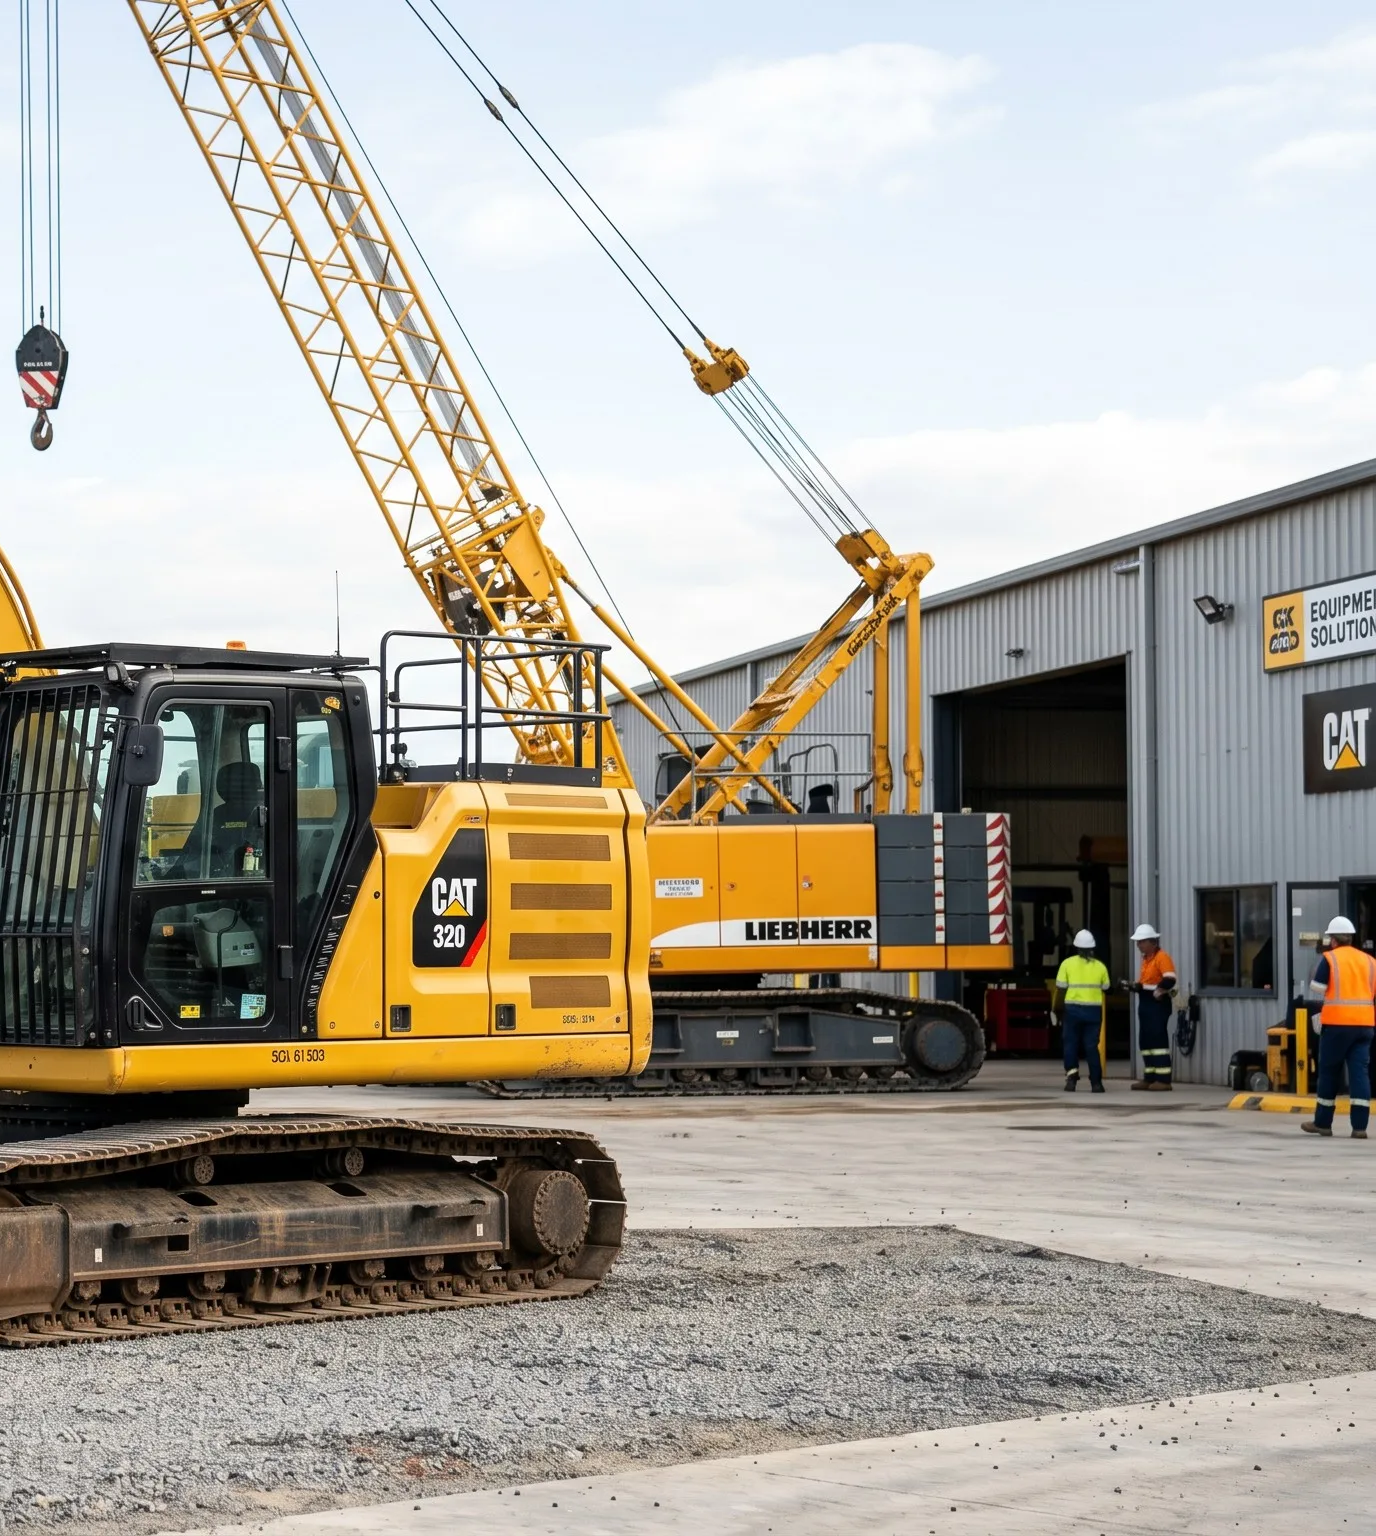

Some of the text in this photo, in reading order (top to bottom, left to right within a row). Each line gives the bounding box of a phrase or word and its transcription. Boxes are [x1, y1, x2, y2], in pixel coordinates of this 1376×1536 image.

[1311, 588, 1376, 623] EQUIPME
[1323, 708, 1370, 771] CAT
[431, 877, 477, 917] CAT
[433, 924, 466, 948] 320
[745, 920, 872, 941] LIEBHERR
